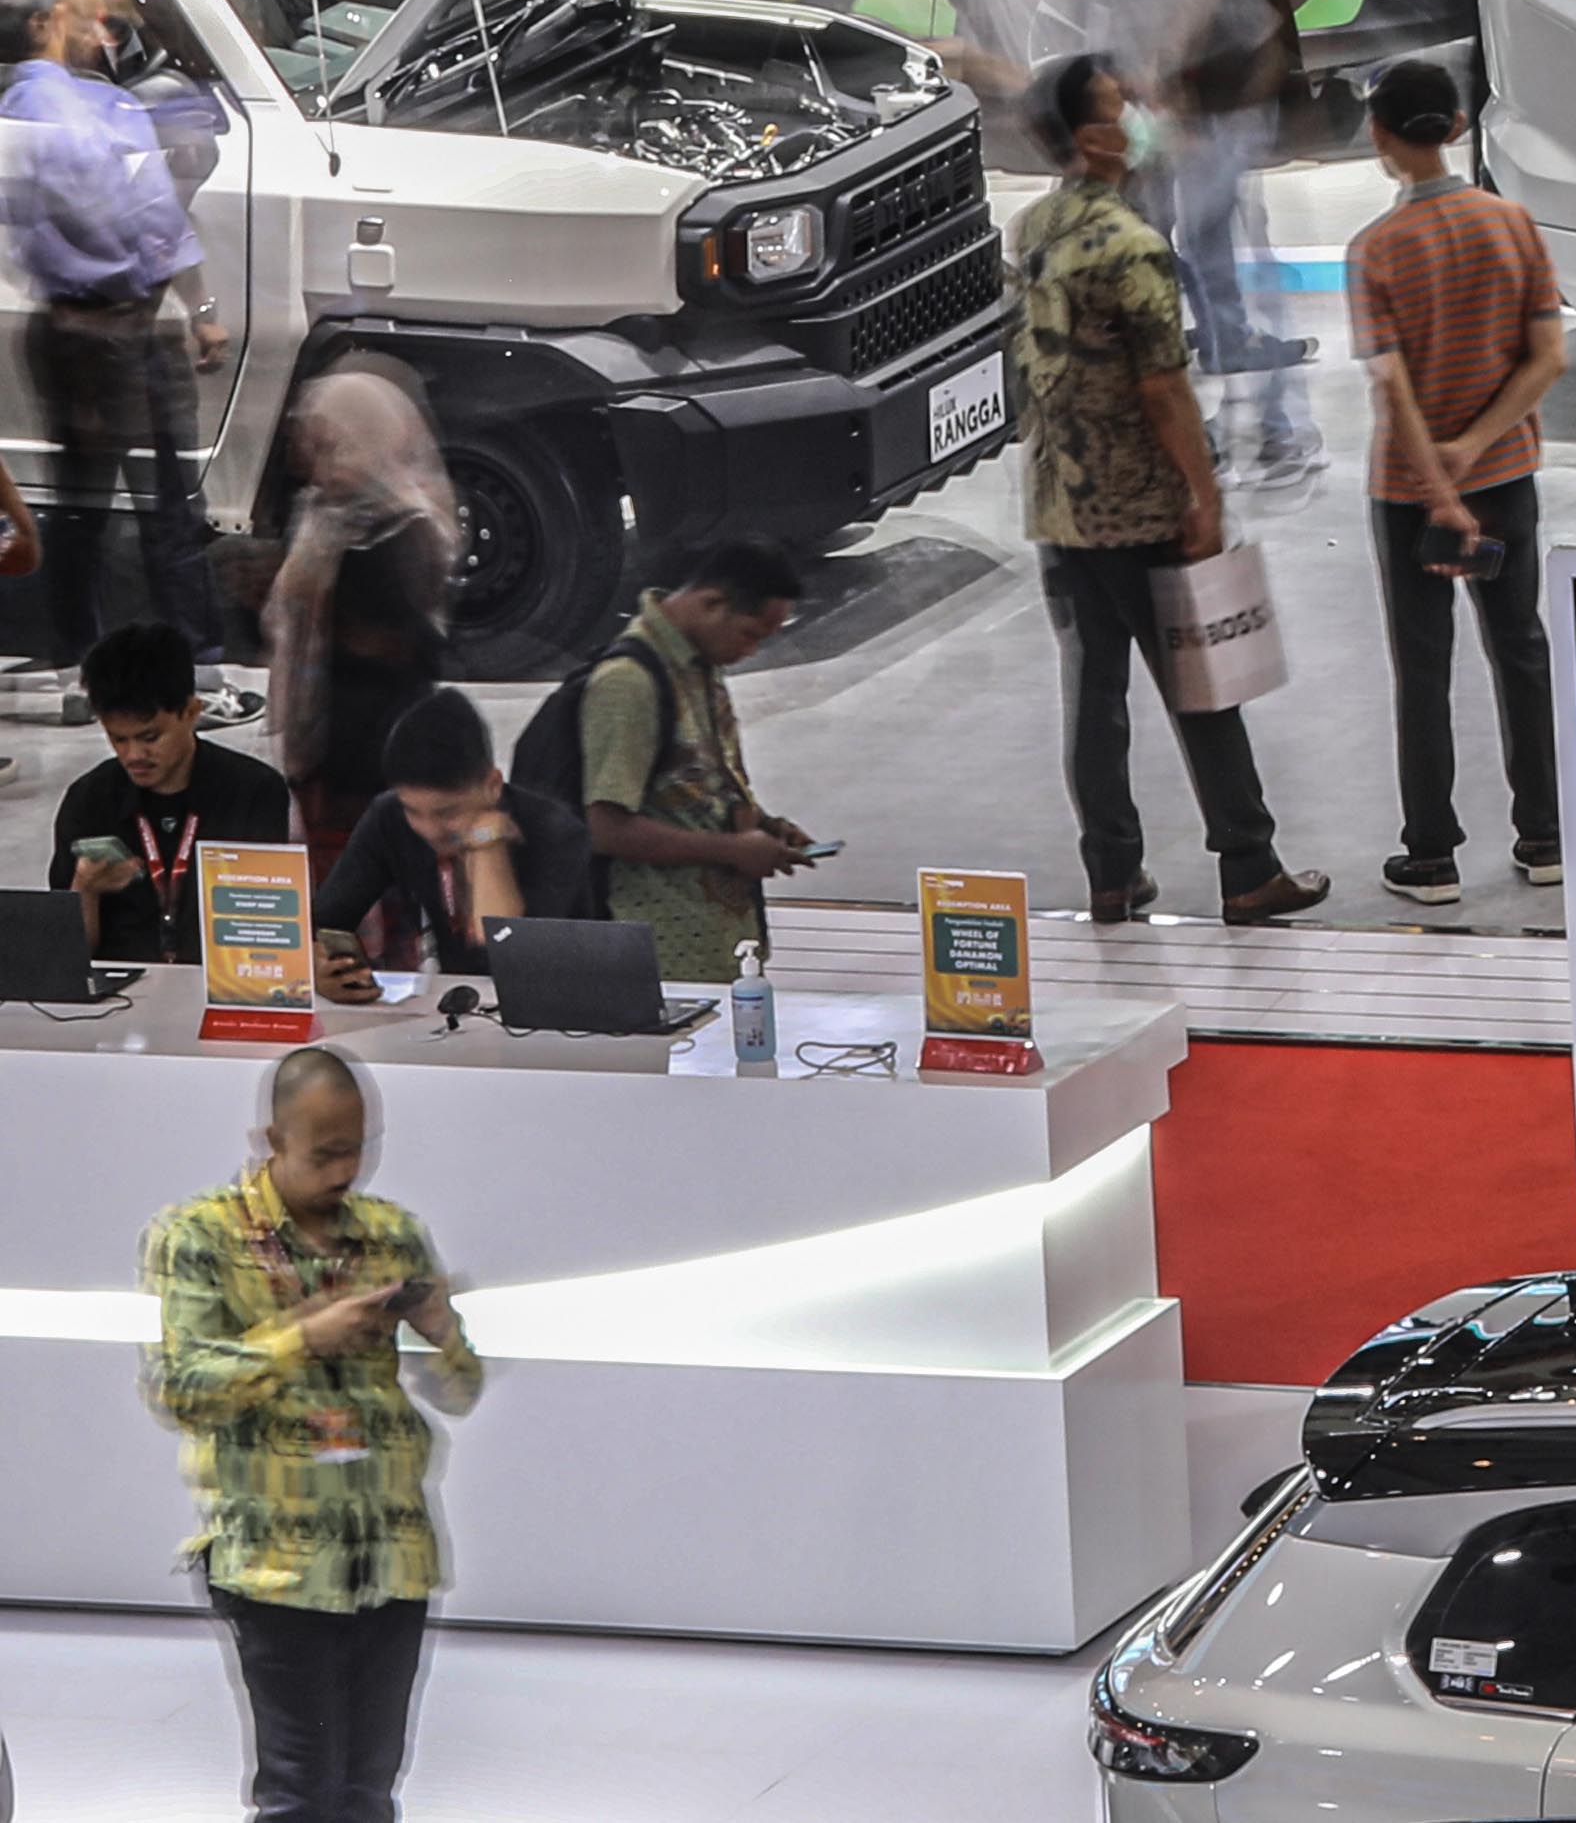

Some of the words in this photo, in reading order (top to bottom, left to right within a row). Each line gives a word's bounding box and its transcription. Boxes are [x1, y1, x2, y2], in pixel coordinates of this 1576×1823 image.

[932, 392, 1002, 454] RANGGA
[951, 929, 982, 938] WHEEL
[986, 931, 999, 939] OF
[954, 940, 998, 949] FORTUNE
[949, 951, 1003, 960] DANAMON
[955, 961, 998, 971] OPTIMAL
